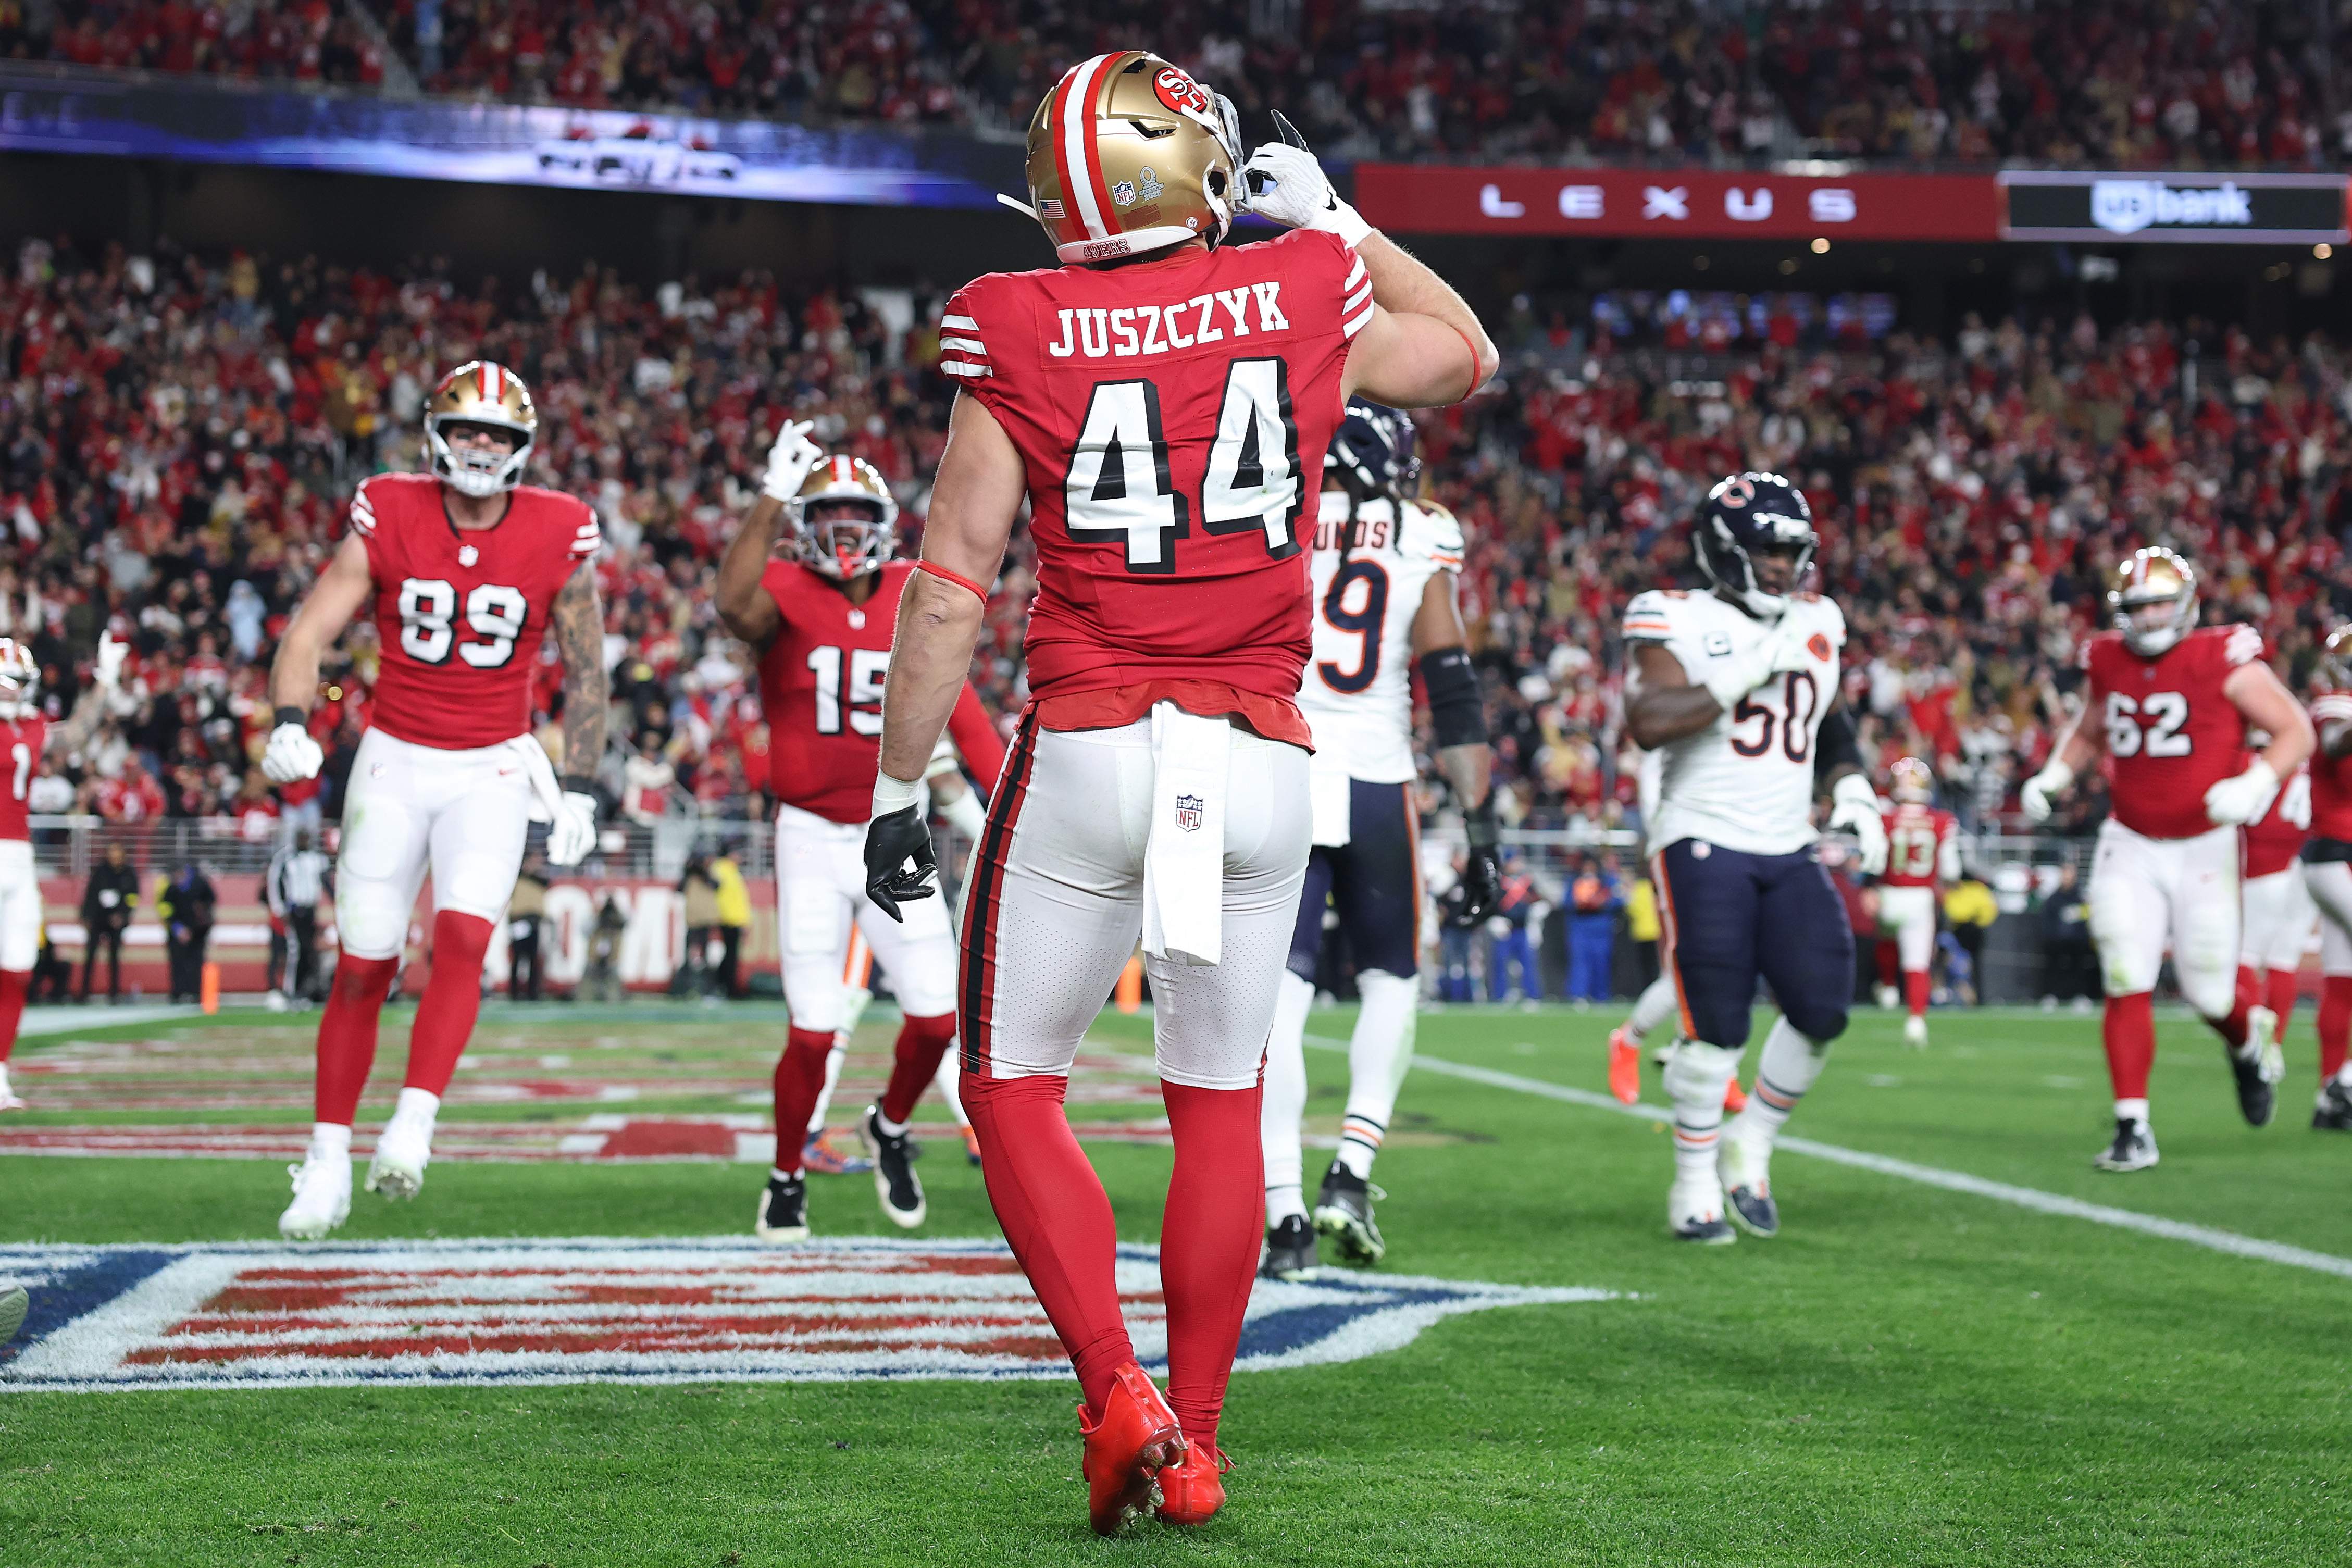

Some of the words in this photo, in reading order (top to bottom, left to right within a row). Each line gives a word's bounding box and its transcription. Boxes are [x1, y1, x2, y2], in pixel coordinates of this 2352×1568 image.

[1117, 191, 1133, 202] NFL
[1480, 183, 1857, 222] LEXUS
[1083, 238, 1131, 260] 49ERS
[1049, 281, 1290, 358] JUSZCZYK
[1063, 356, 1303, 573] 44
[398, 577, 527, 667] 89
[807, 645, 890, 736] 15
[1730, 670, 1818, 763] 50
[2105, 691, 2192, 758] 62
[1179, 810, 1199, 828] NFL
[1891, 827, 1938, 878] 13
